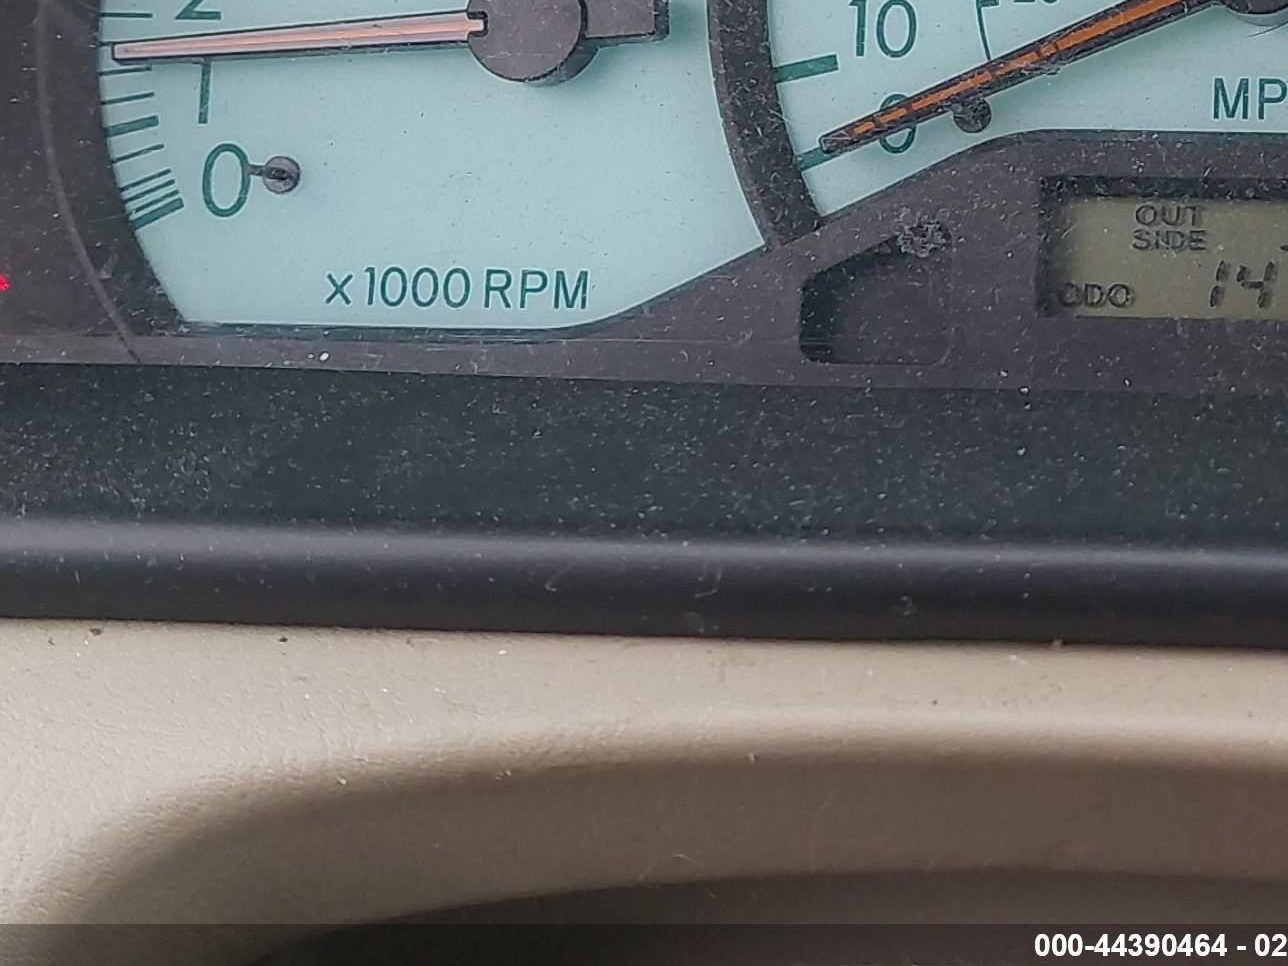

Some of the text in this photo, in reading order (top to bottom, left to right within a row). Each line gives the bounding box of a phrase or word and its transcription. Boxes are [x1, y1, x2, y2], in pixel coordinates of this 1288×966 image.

[202, 143, 250, 218] 0
[1134, 205, 1203, 226] OUT
[1132, 231, 1206, 251] SIDE
[326, 267, 588, 309] x1000 RPM
[1059, 283, 1133, 308] ODO
